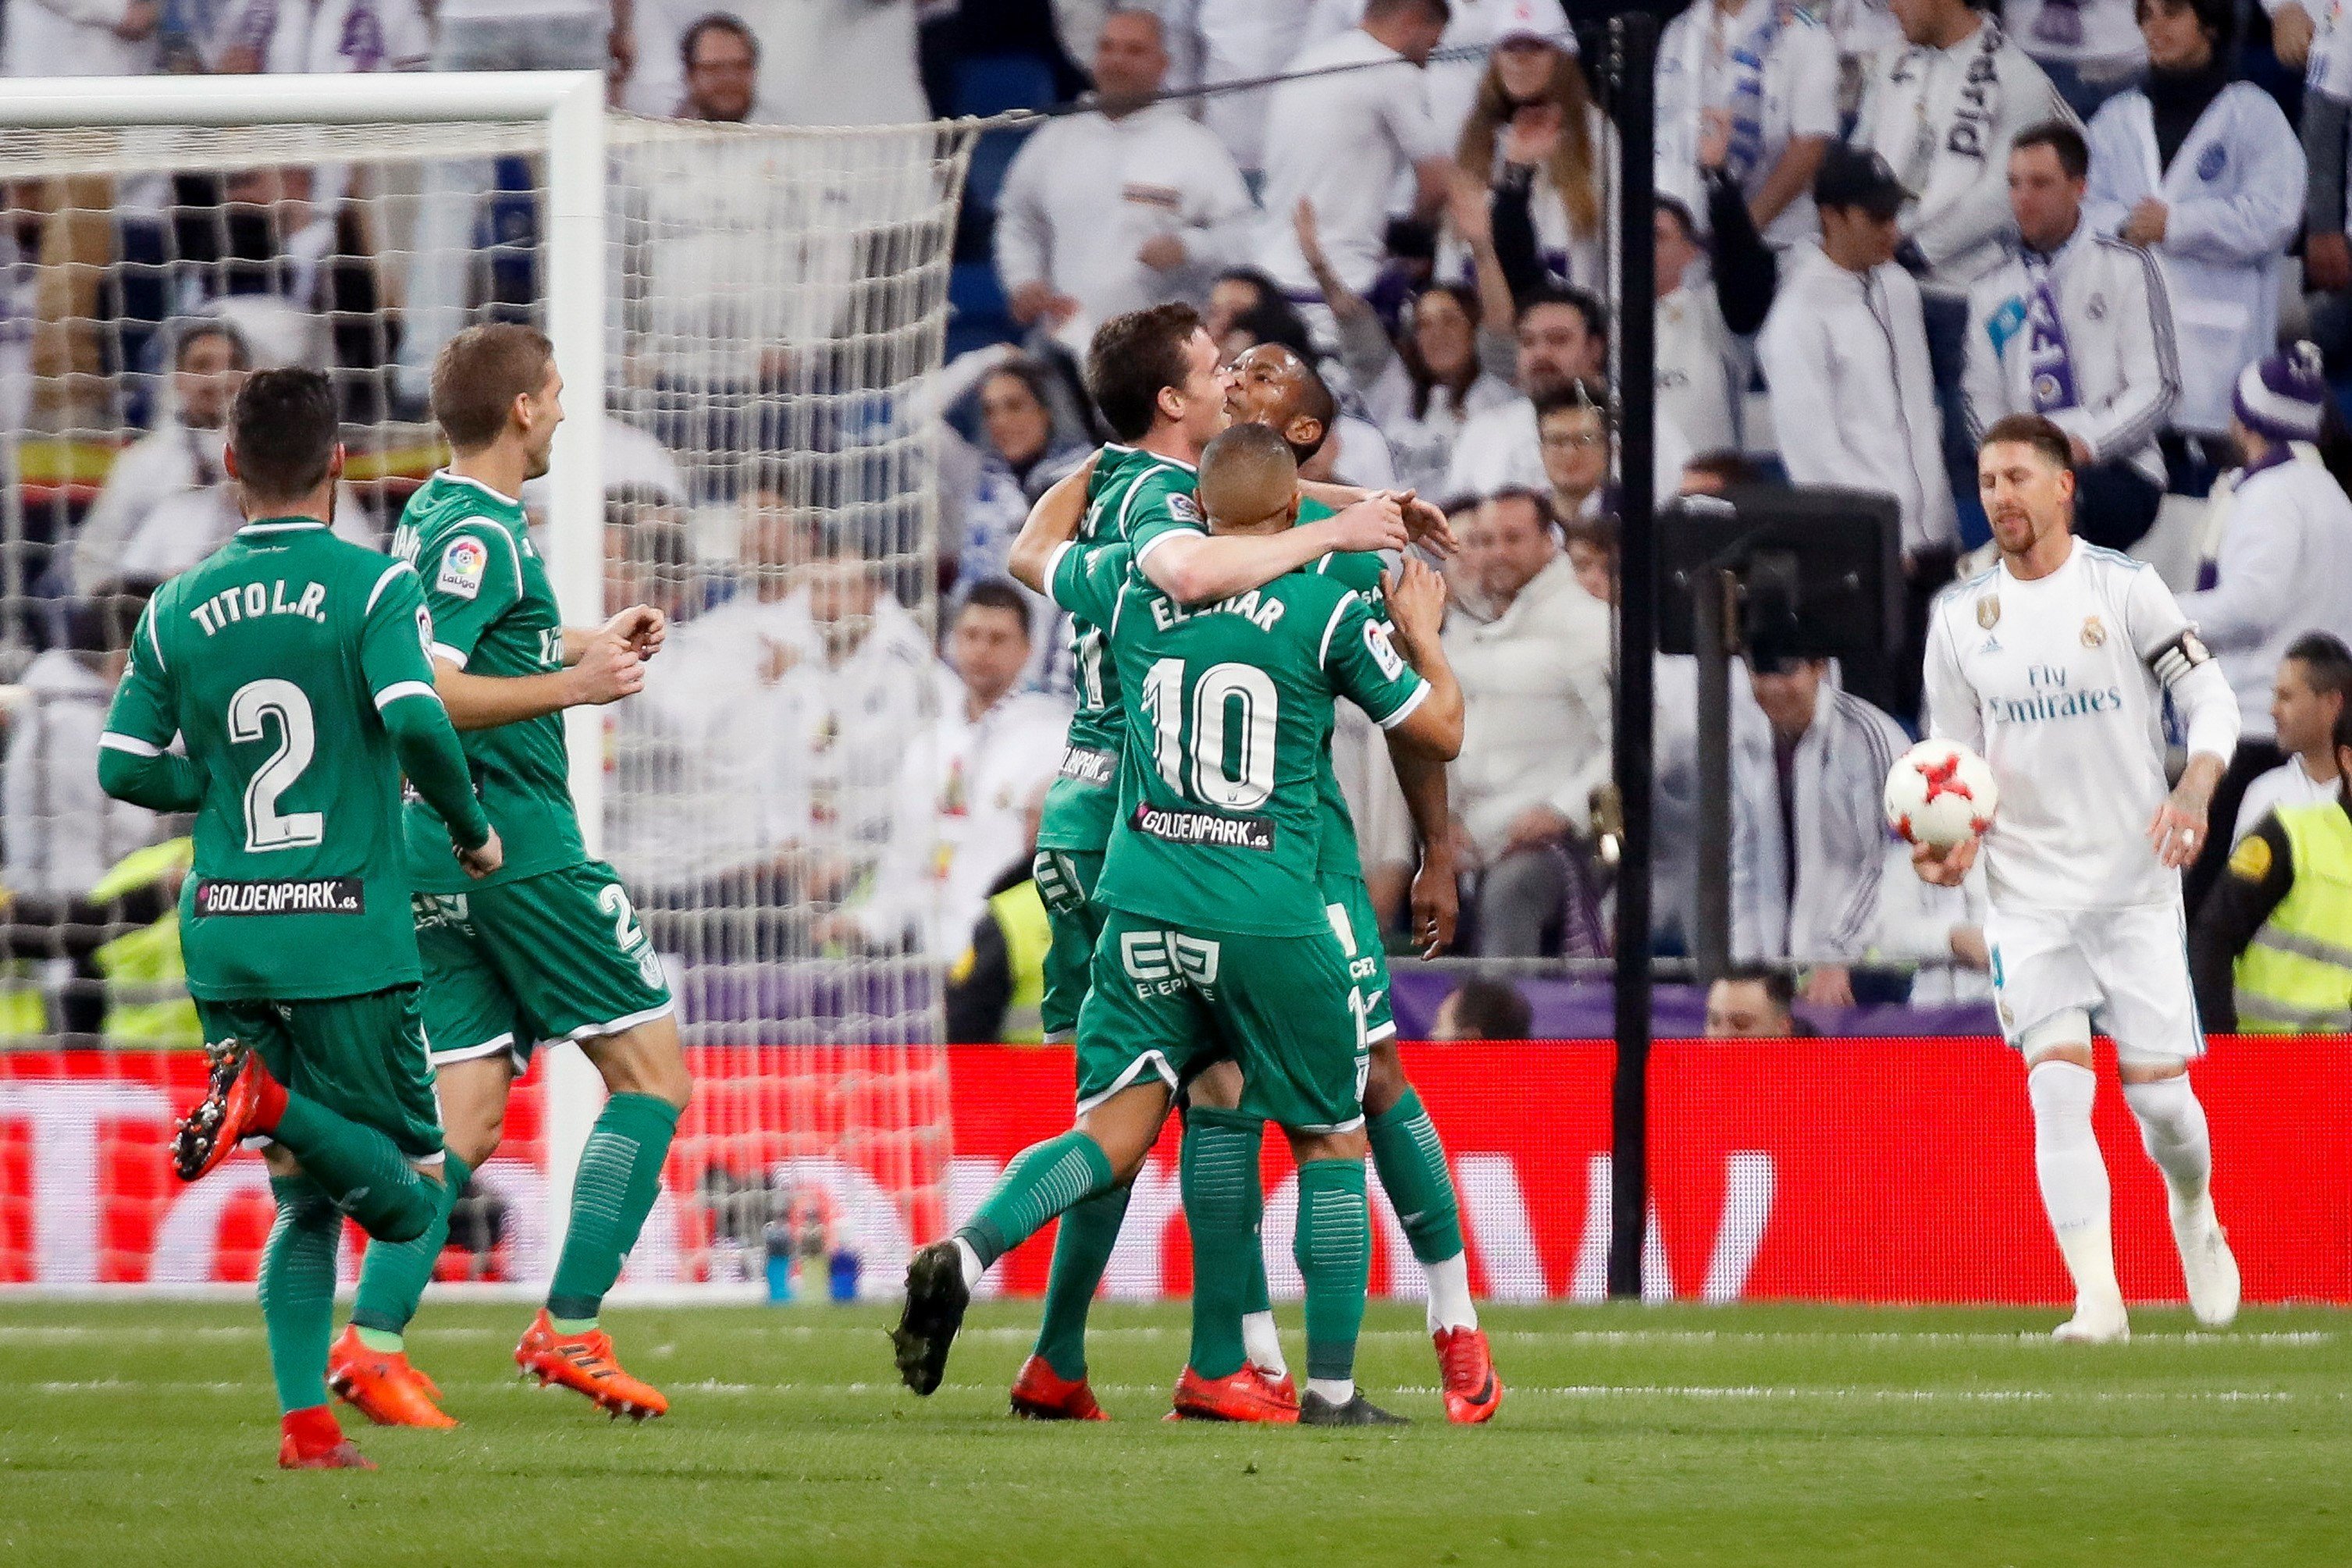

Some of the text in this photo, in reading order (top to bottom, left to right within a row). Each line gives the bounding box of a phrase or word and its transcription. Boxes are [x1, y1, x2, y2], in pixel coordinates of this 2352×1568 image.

[442, 572, 476, 590] LaLiga
[189, 579, 326, 637] TITO L.R.
[2027, 662, 2066, 688] Fly
[1989, 686, 2122, 724] Emirates
[1140, 657, 1279, 810] 10
[227, 677, 323, 854] 2
[1141, 810, 1270, 847] GOLDENPARK.es
[208, 880, 358, 913] GOLDENPARK.es
